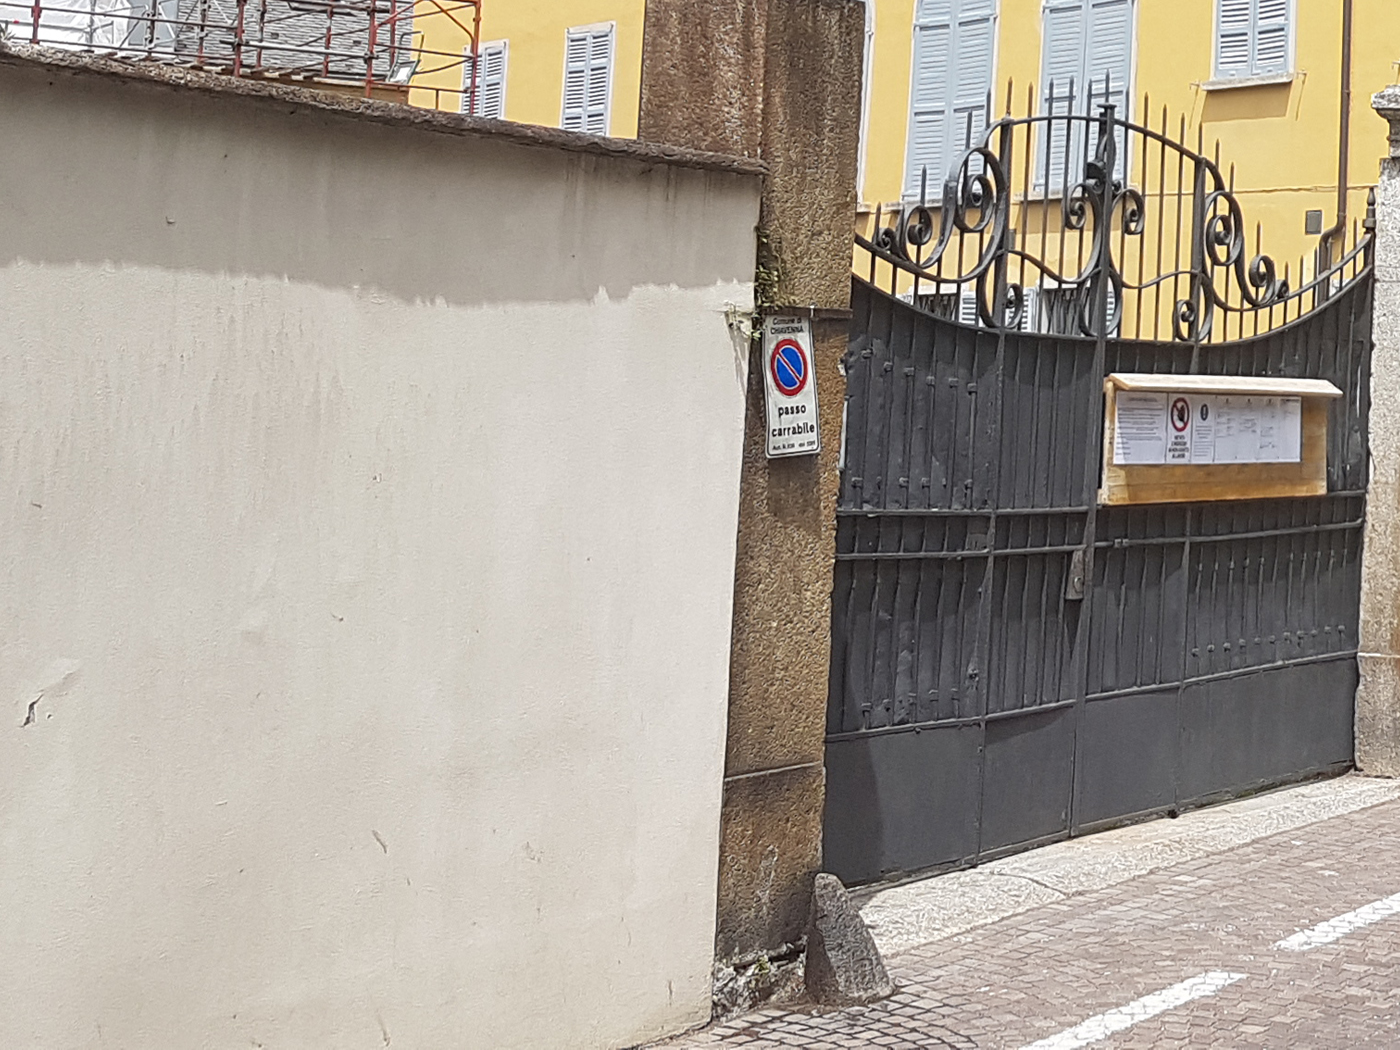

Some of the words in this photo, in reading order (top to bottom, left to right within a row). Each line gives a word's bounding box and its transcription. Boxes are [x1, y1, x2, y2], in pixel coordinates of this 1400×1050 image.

[771, 325, 804, 334] CHIAVENNA
[778, 404, 807, 418] passo
[772, 422, 815, 437] carrabile
